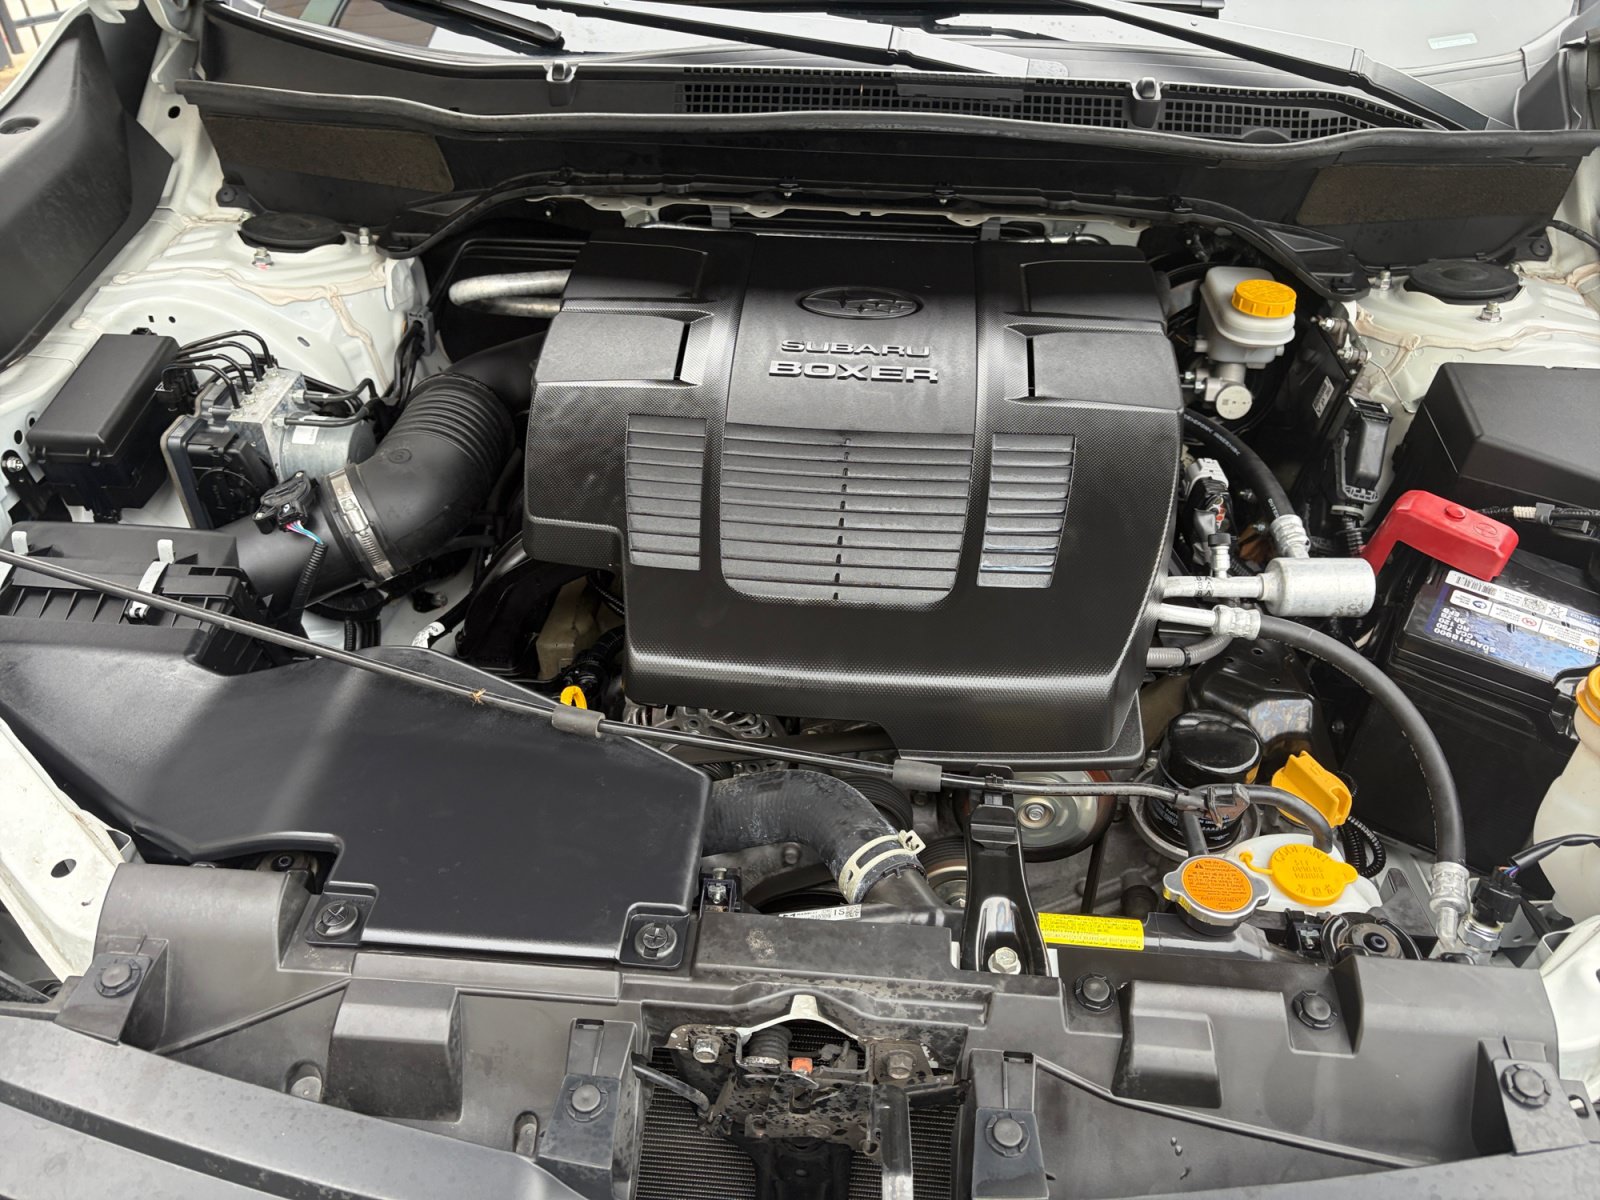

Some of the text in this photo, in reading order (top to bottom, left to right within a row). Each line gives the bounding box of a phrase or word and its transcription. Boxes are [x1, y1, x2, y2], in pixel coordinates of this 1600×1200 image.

[781, 339, 930, 358] SUBARU
[768, 360, 940, 384] BOXER
[1438, 617, 1455, 627] 120
[1455, 628, 1473, 640] CCA
